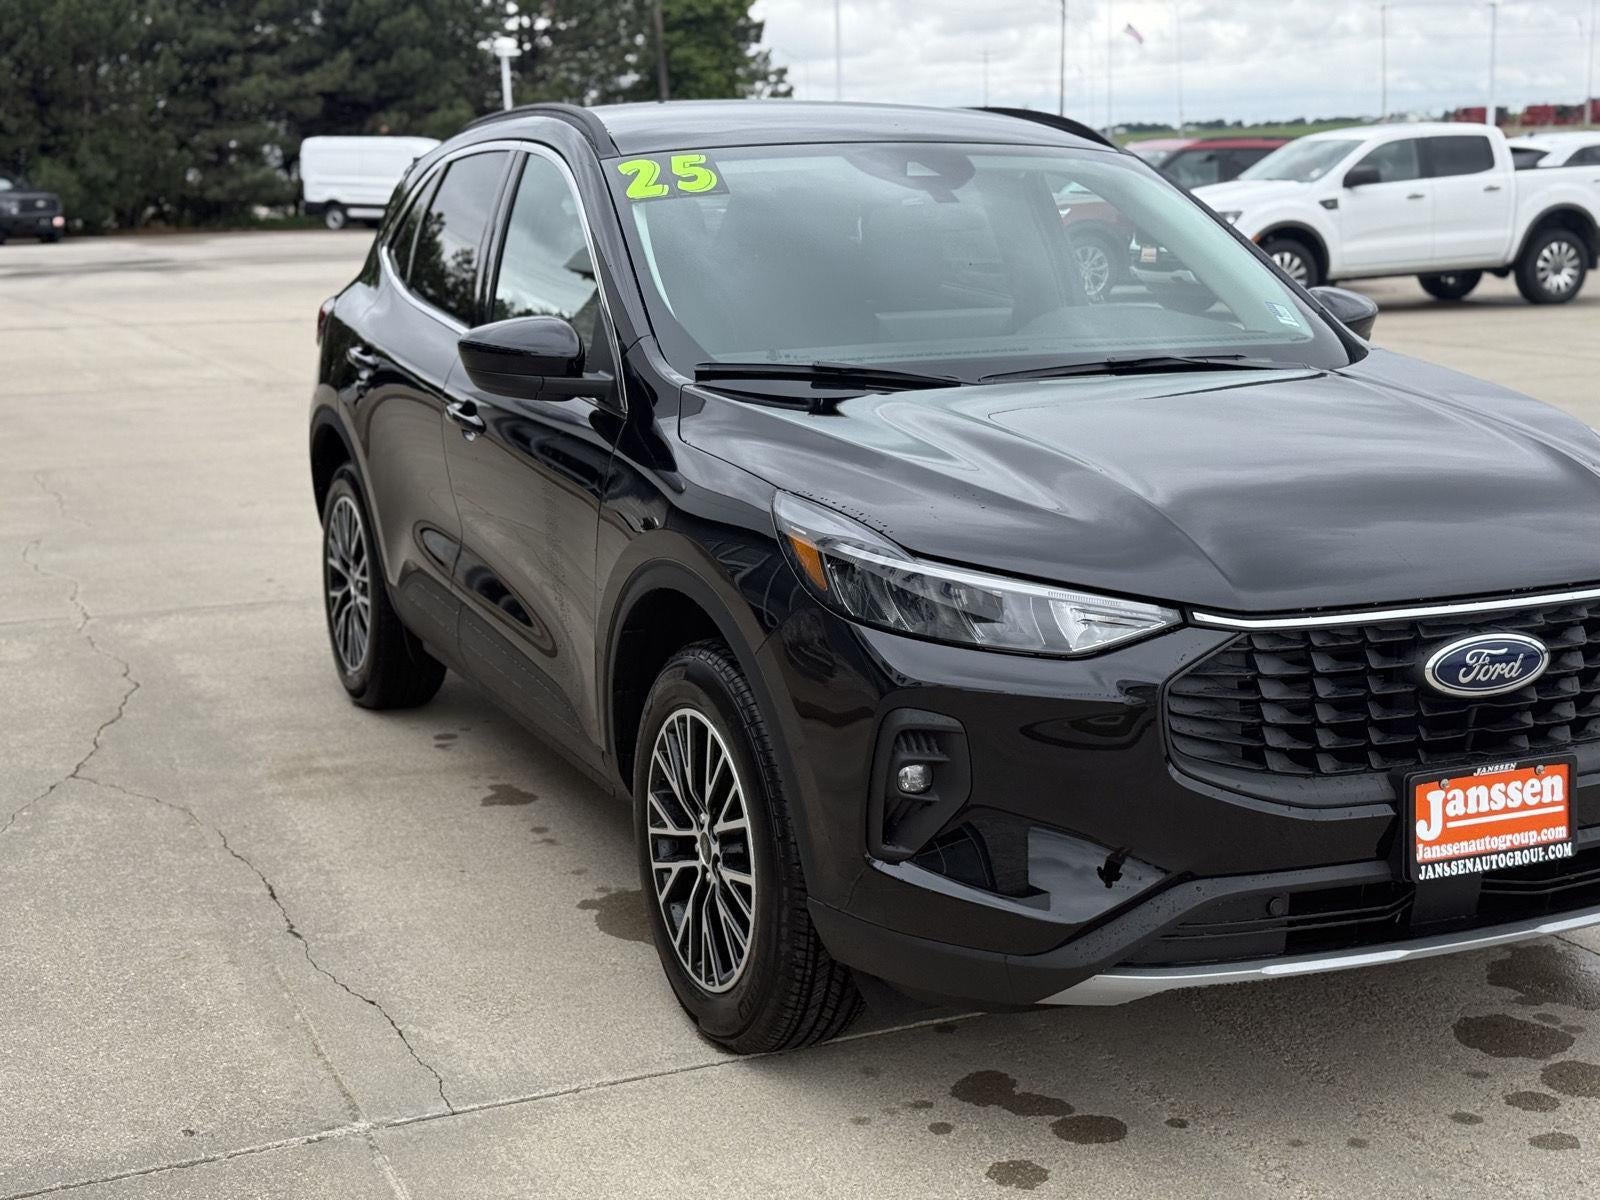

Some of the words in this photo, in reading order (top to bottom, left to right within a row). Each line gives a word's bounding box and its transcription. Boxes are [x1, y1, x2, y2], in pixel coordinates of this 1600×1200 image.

[618, 154, 718, 199] 25
[1458, 647, 1525, 684] Ford
[1473, 762, 1517, 777] JANSSEN
[1415, 773, 1564, 841] Janssen
[1416, 824, 1567, 860] Janssenautogroup.com
